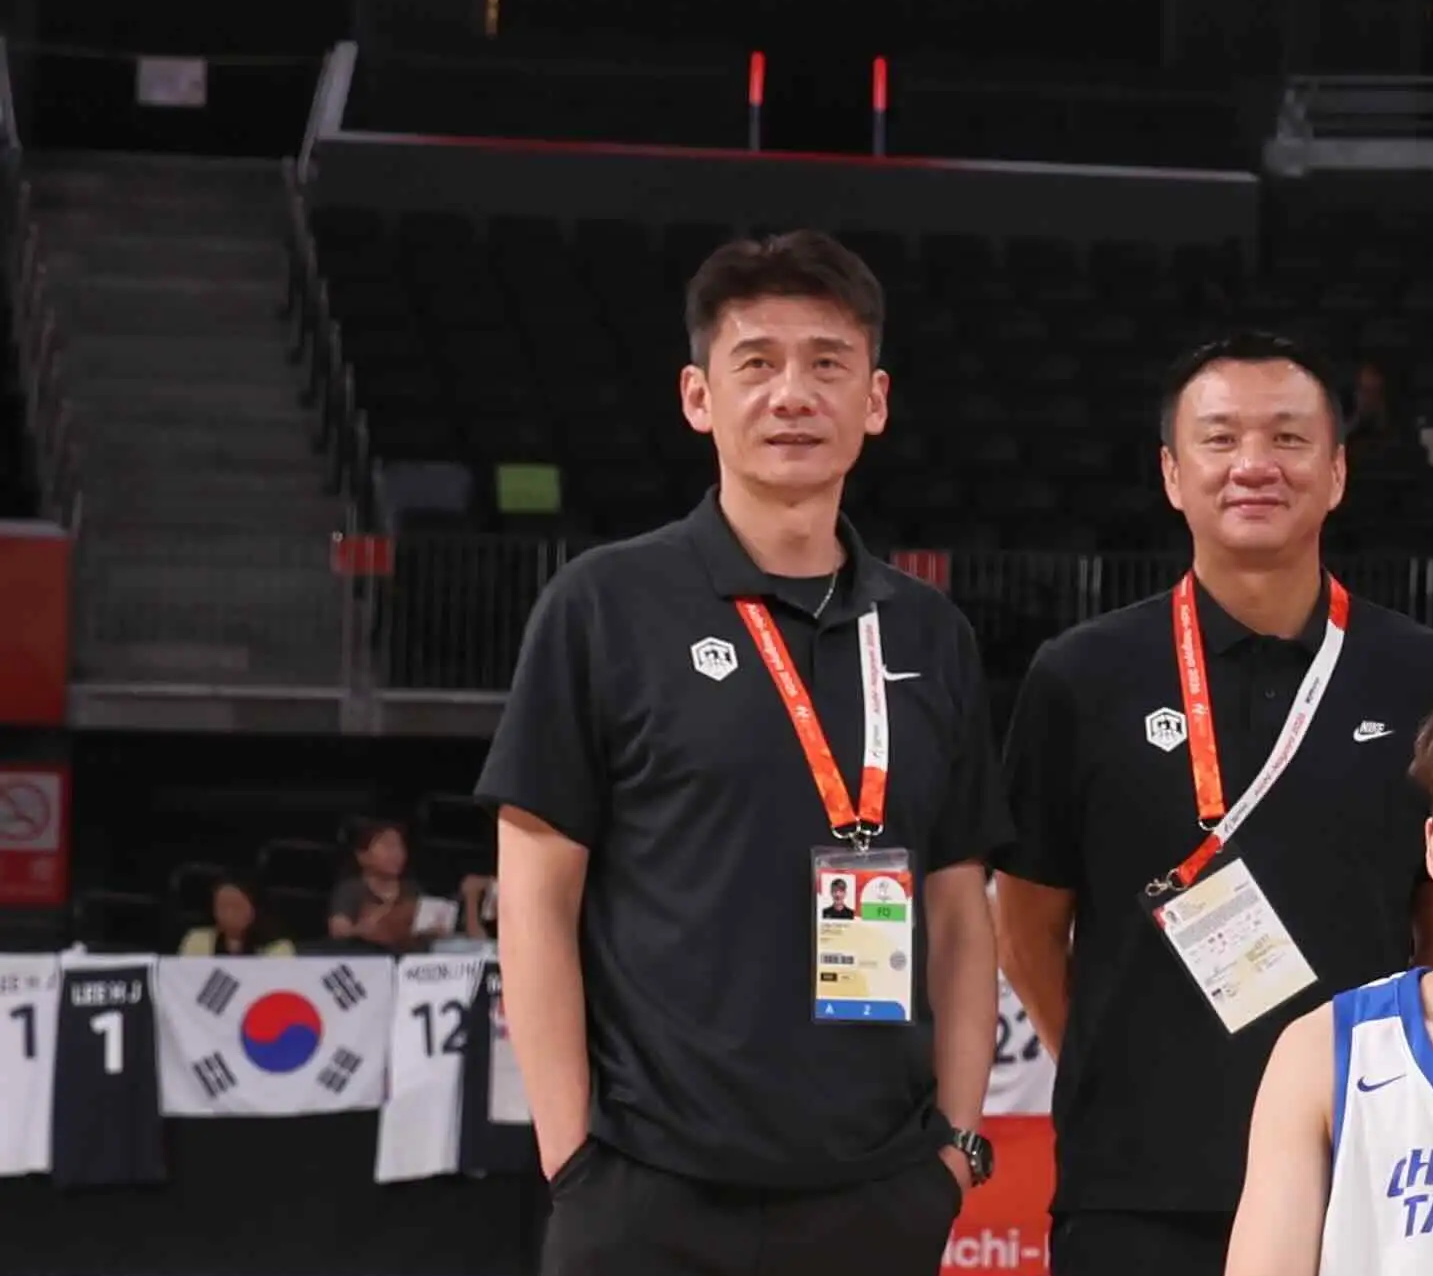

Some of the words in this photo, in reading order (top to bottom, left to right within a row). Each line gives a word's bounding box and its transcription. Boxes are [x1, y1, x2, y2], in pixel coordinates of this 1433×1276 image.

[9, 1002, 36, 1059] 1
[90, 1010, 123, 1075] 1
[411, 1000, 469, 1058] 12
